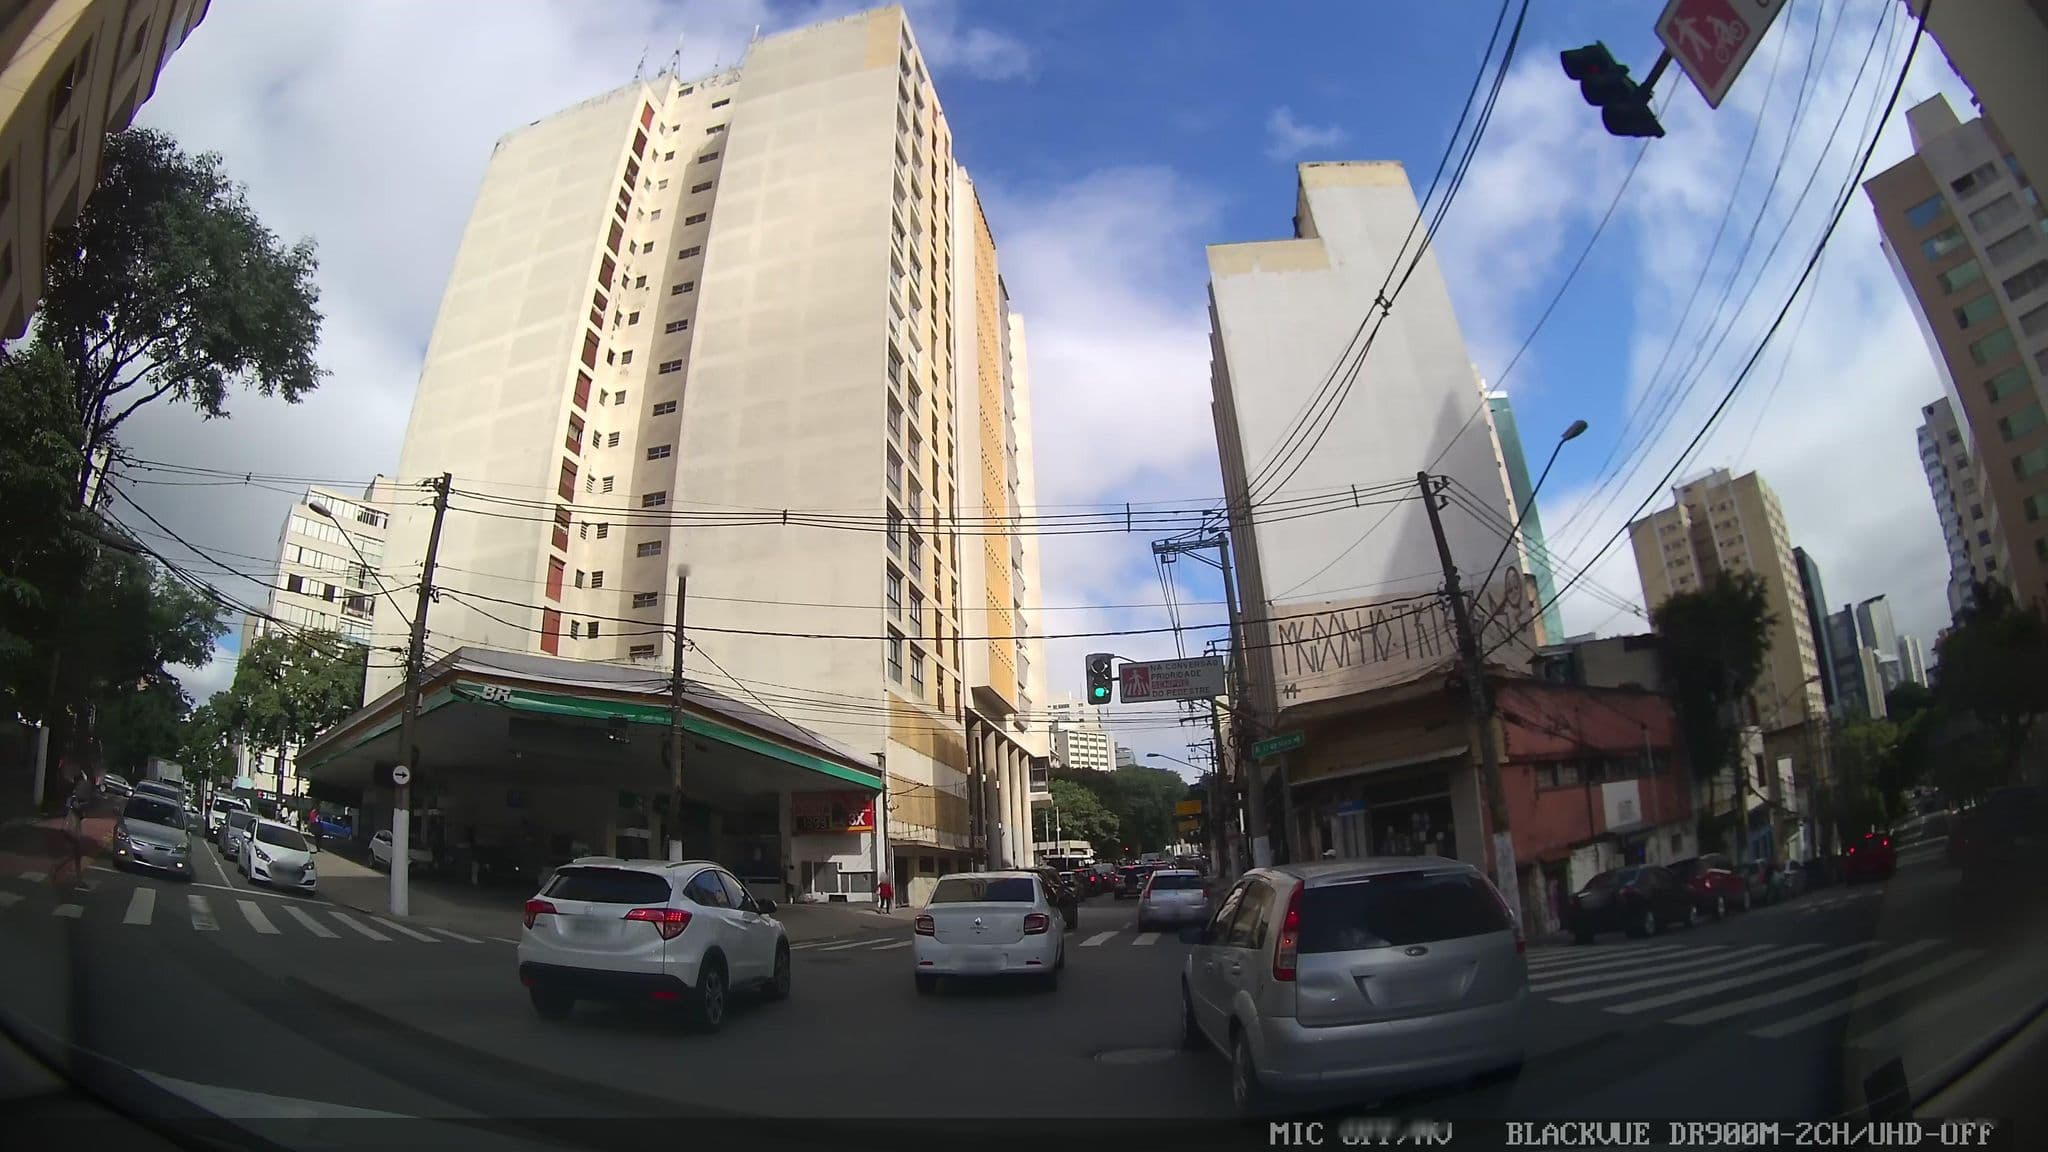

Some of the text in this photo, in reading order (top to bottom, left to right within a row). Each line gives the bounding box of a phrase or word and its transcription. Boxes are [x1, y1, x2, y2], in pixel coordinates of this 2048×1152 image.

[1150, 664, 1163, 672] NA
[1151, 670, 1201, 680] PRIORIDADE
[482, 685, 513, 703] BR
[1152, 687, 1209, 697] DO PEDESTRE
